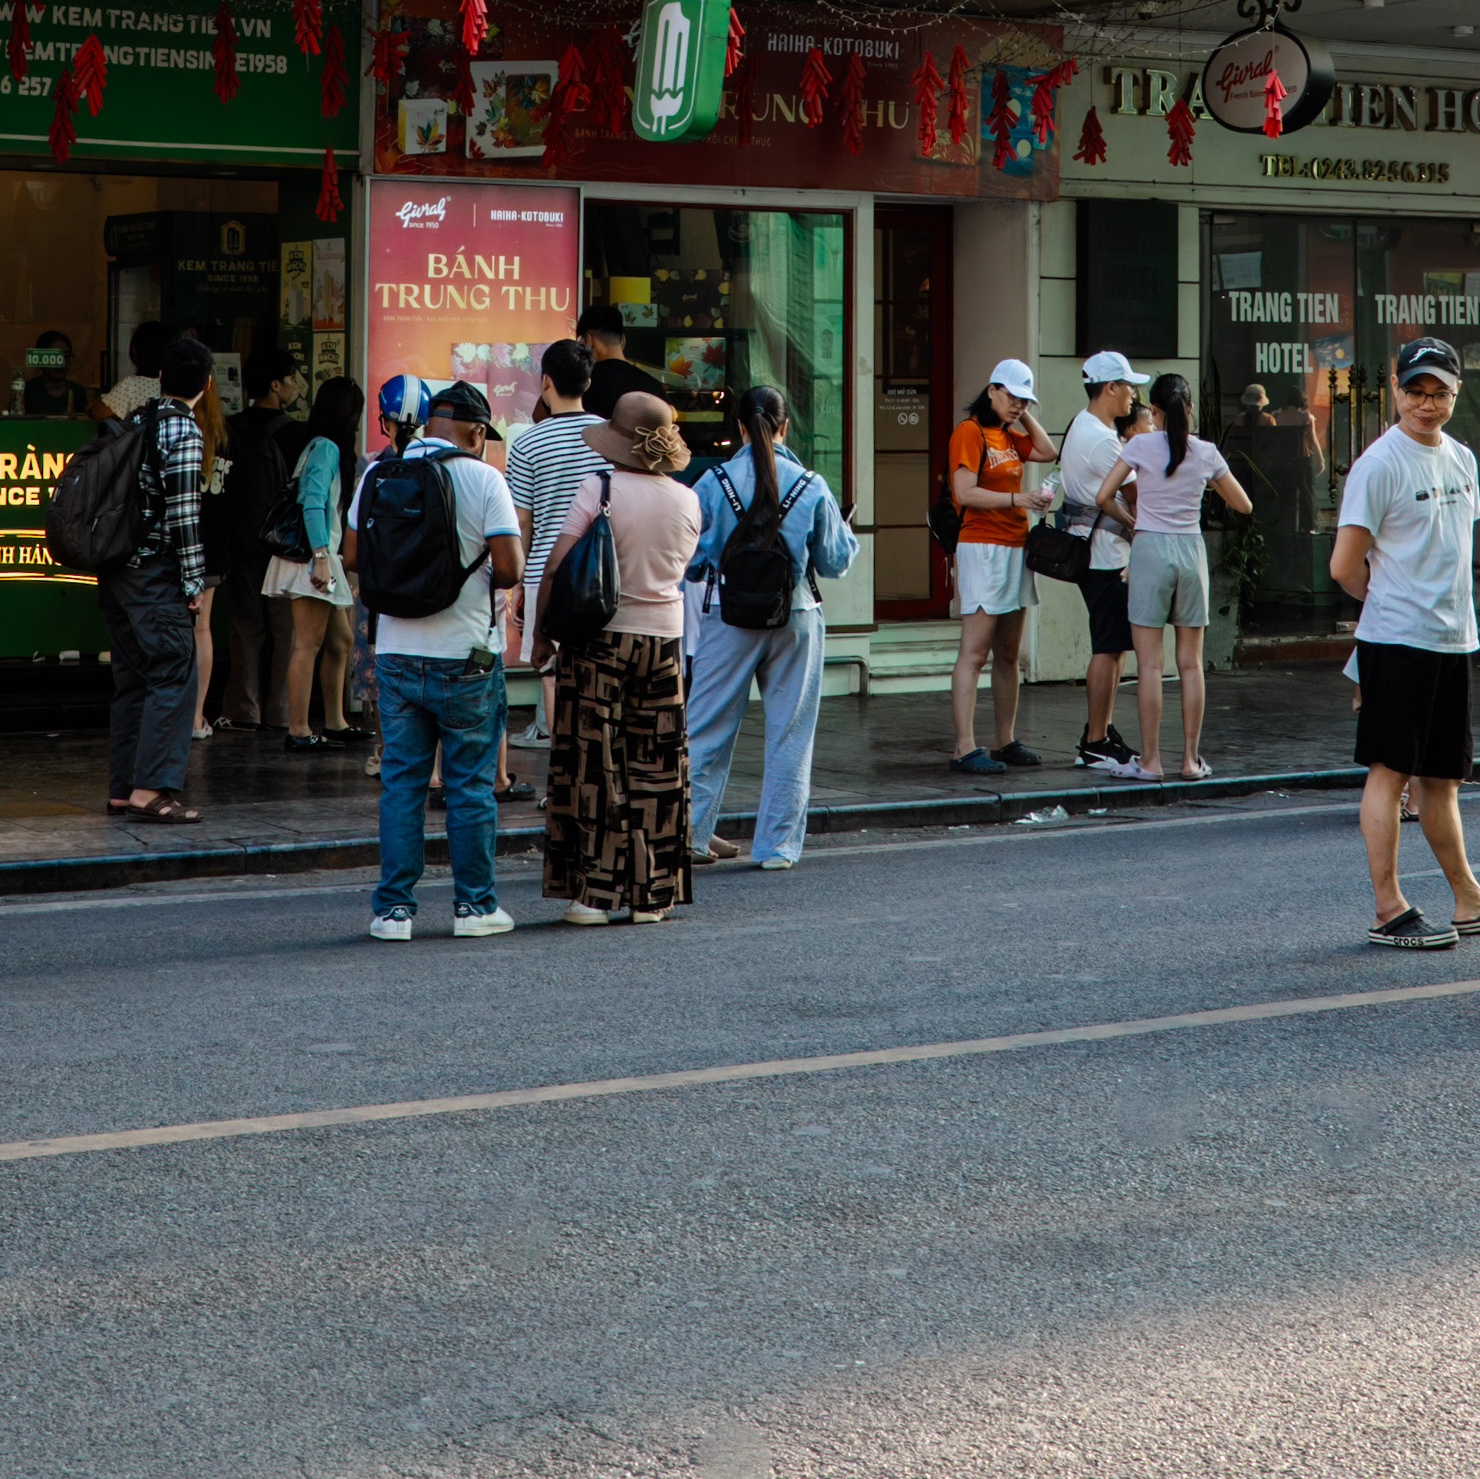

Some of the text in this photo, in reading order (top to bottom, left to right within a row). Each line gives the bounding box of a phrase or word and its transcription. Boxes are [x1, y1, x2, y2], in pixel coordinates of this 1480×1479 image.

[18, 75, 53, 97] 257
[1216, 50, 1273, 104] Givral
[1104, 66, 1214, 121] TRA
[861, 99, 910, 130] HU
[427, 245, 521, 280] BÁNH
[375, 283, 570, 312] TRUNG THU
[1229, 291, 1339, 324] TRANG TIEN
[1375, 294, 1480, 326] TRANG TIEN
[28, 353, 65, 366] 10.000
[1256, 342, 1313, 374] HOTEL
[782, 478, 807, 509] LI-NING
